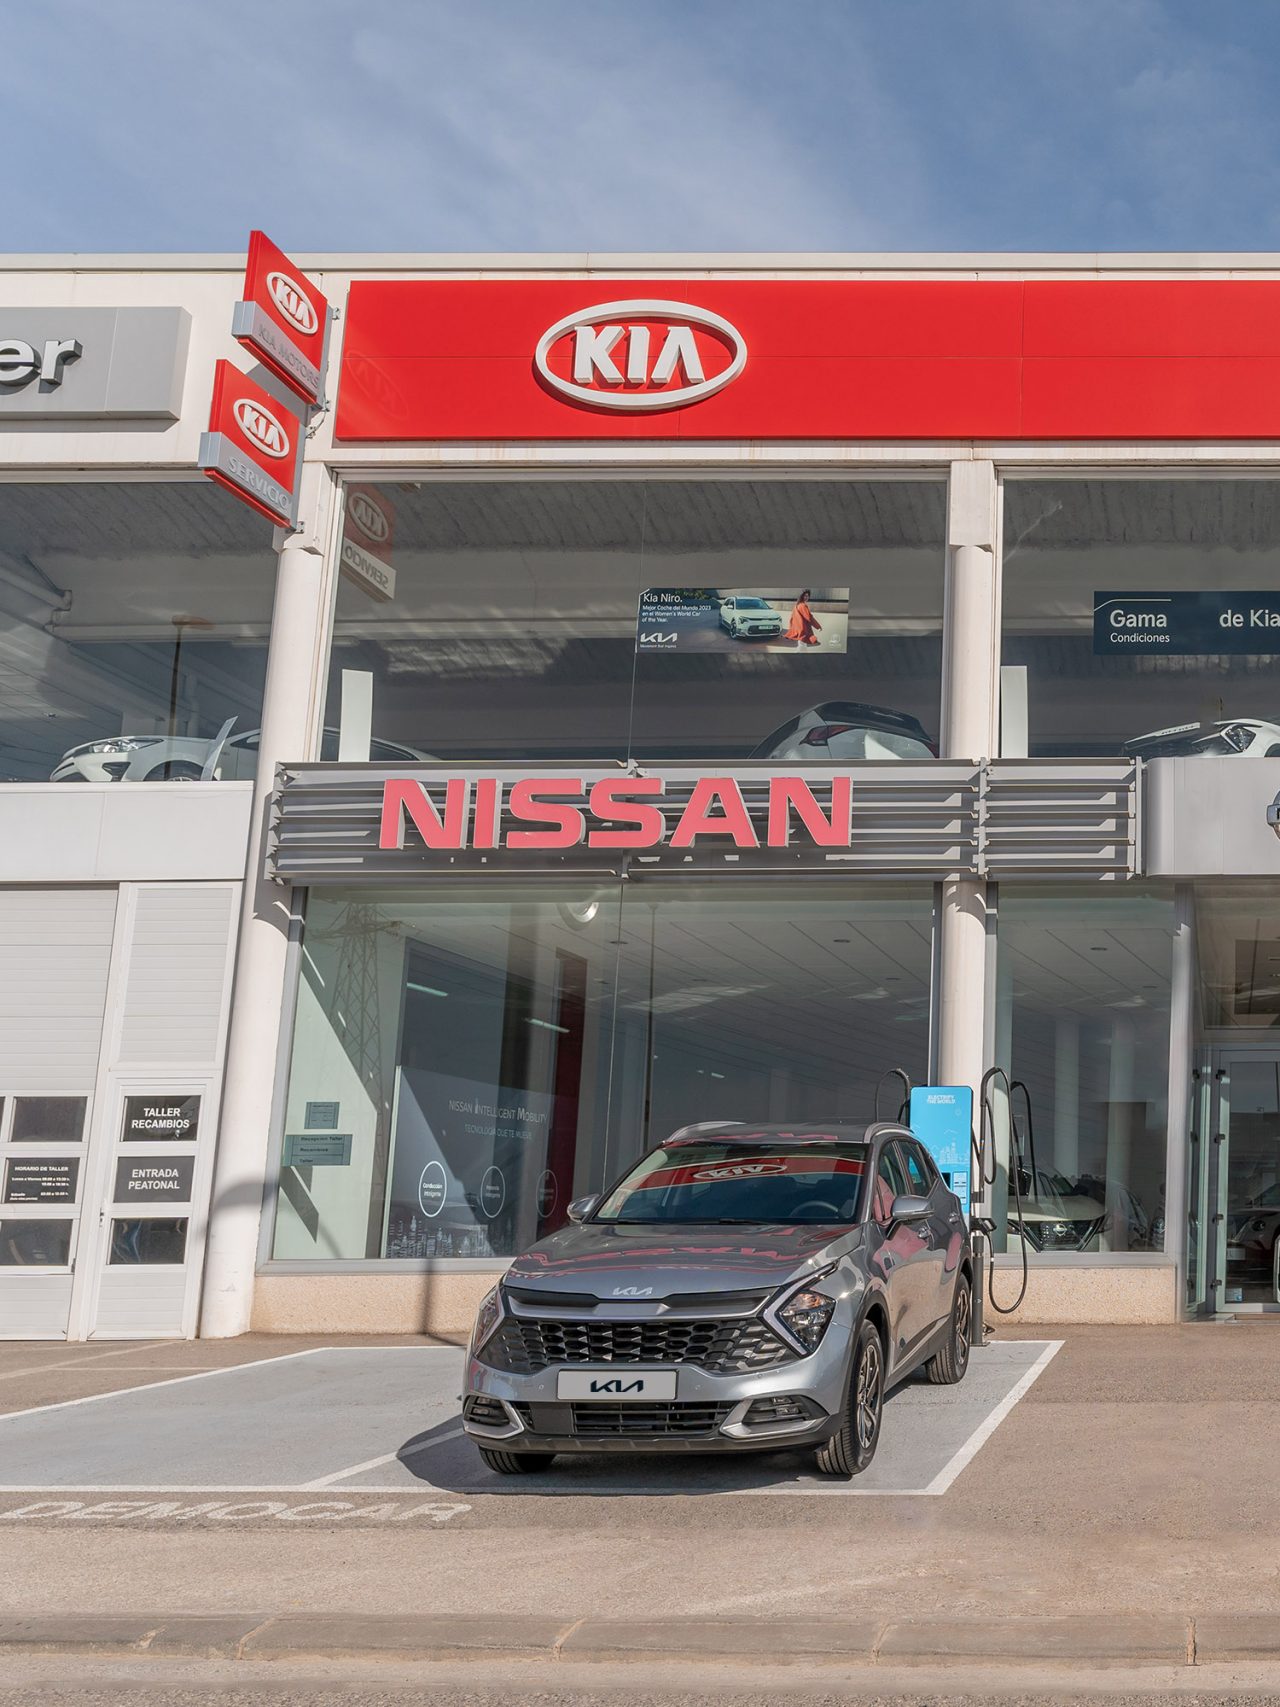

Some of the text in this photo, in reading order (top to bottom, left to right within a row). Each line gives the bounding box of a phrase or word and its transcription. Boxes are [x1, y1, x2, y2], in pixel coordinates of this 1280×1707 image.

[272, 278, 310, 328] KIA
[257, 323, 320, 389] KIA MOTORS
[574, 325, 706, 384] KIA
[242, 408, 281, 449] KIA
[227, 455, 290, 511] SERVICIO
[643, 593, 683, 602] Kia Niro.
[1109, 609, 1168, 628] Gama
[1219, 608, 1244, 628] de
[640, 632, 678, 643] KIA
[1110, 631, 1170, 644] Condiciones
[379, 776, 853, 850] NISSAN
[143, 1107, 181, 1117] TALLER
[449, 1099, 473, 1114] NISSAN
[131, 1119, 190, 1129] RECAMBIOS
[131, 1168, 179, 1179] ENTRADA
[128, 1181, 180, 1190] PEATONAL
[590, 1379, 644, 1393] KIA
[0, 1501, 473, 1522] DEMOCAR
